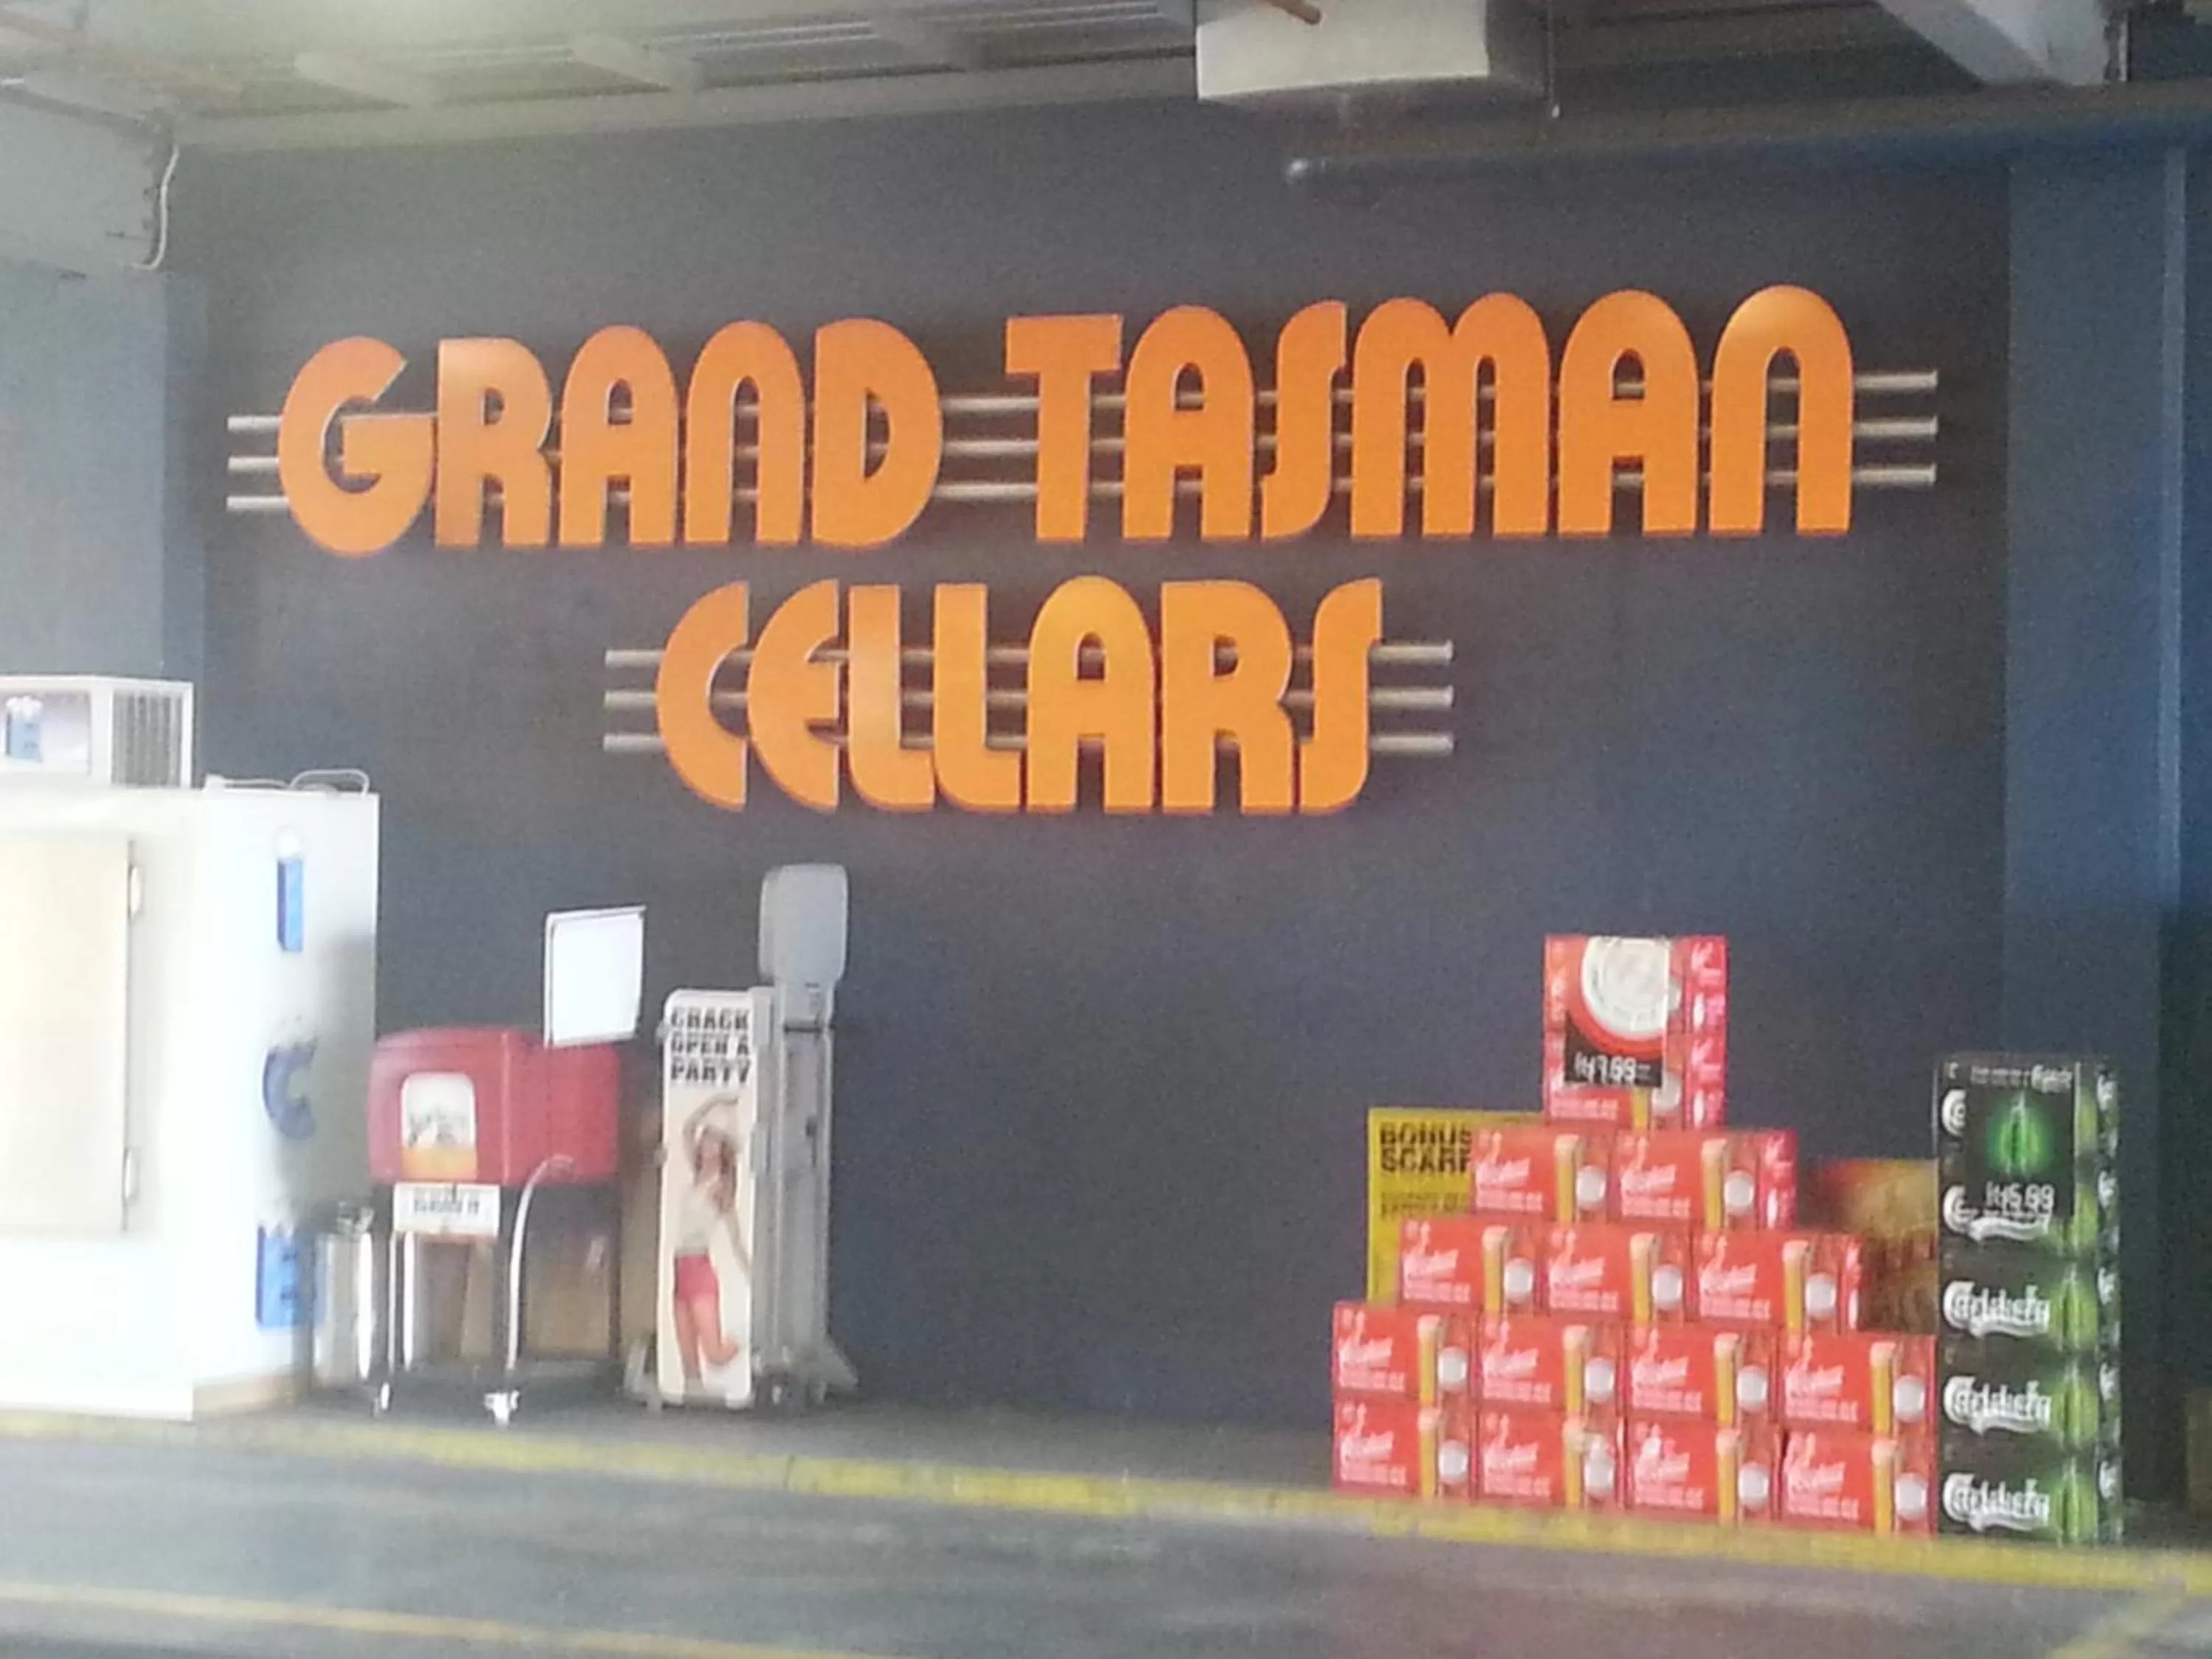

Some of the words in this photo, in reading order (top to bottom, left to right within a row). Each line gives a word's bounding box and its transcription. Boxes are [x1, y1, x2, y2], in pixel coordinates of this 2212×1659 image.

[277, 319, 944, 557] GRAND
[1004, 285, 1855, 544] TASMAN
[655, 575, 1385, 816] CELLARS
[669, 1006, 751, 1031] CRACK
[669, 1032, 729, 1055] OPEN
[669, 1057, 751, 1084] PARTY
[1943, 1280, 2050, 1338] Carlsberg
[1943, 1376, 2052, 1435] Carlsberg
[1943, 1473, 2050, 1531] Carlsberg
